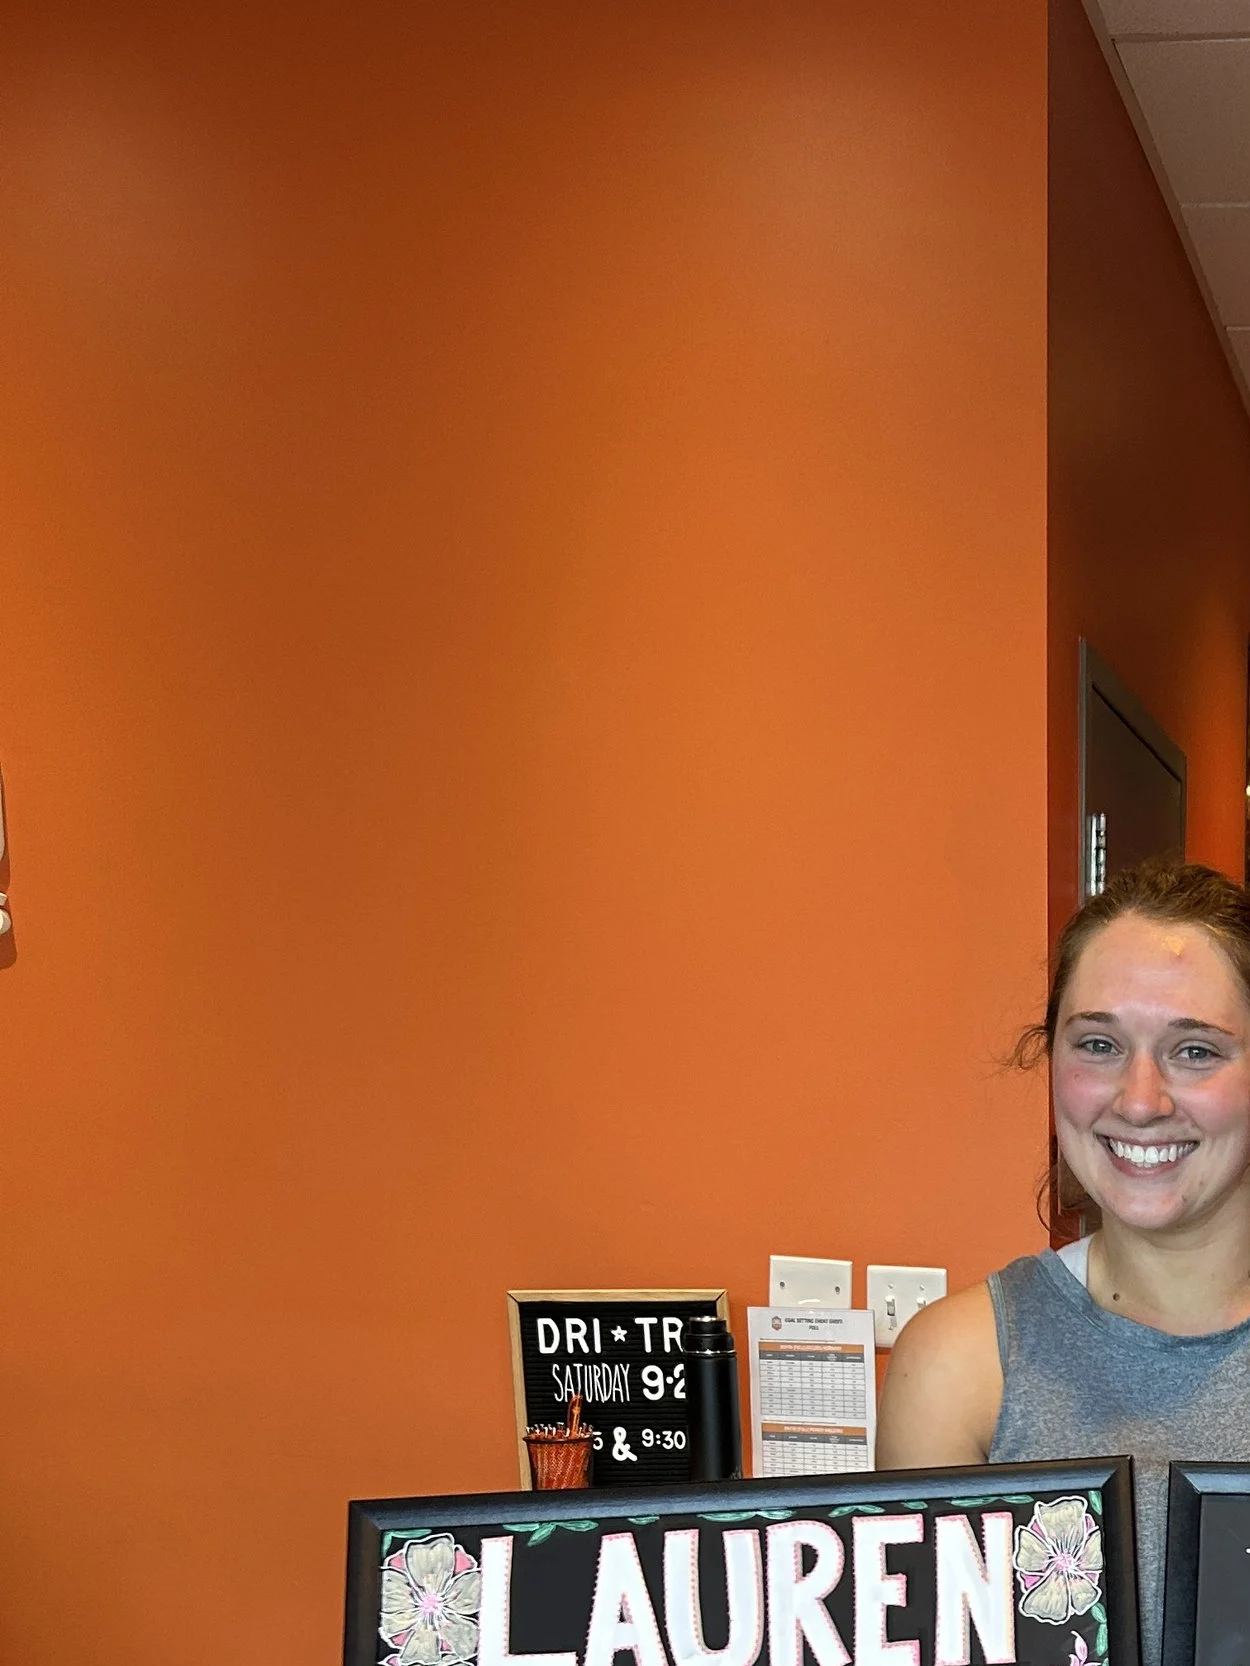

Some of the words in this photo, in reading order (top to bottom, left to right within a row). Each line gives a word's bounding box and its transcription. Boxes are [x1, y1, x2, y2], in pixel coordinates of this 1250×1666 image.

[537, 1317, 601, 1354] DRI
[635, 1317, 683, 1354] TR
[552, 1363, 630, 1403] SATURDAY
[612, 1426, 638, 1462] &
[642, 1429, 686, 1450] 9:30
